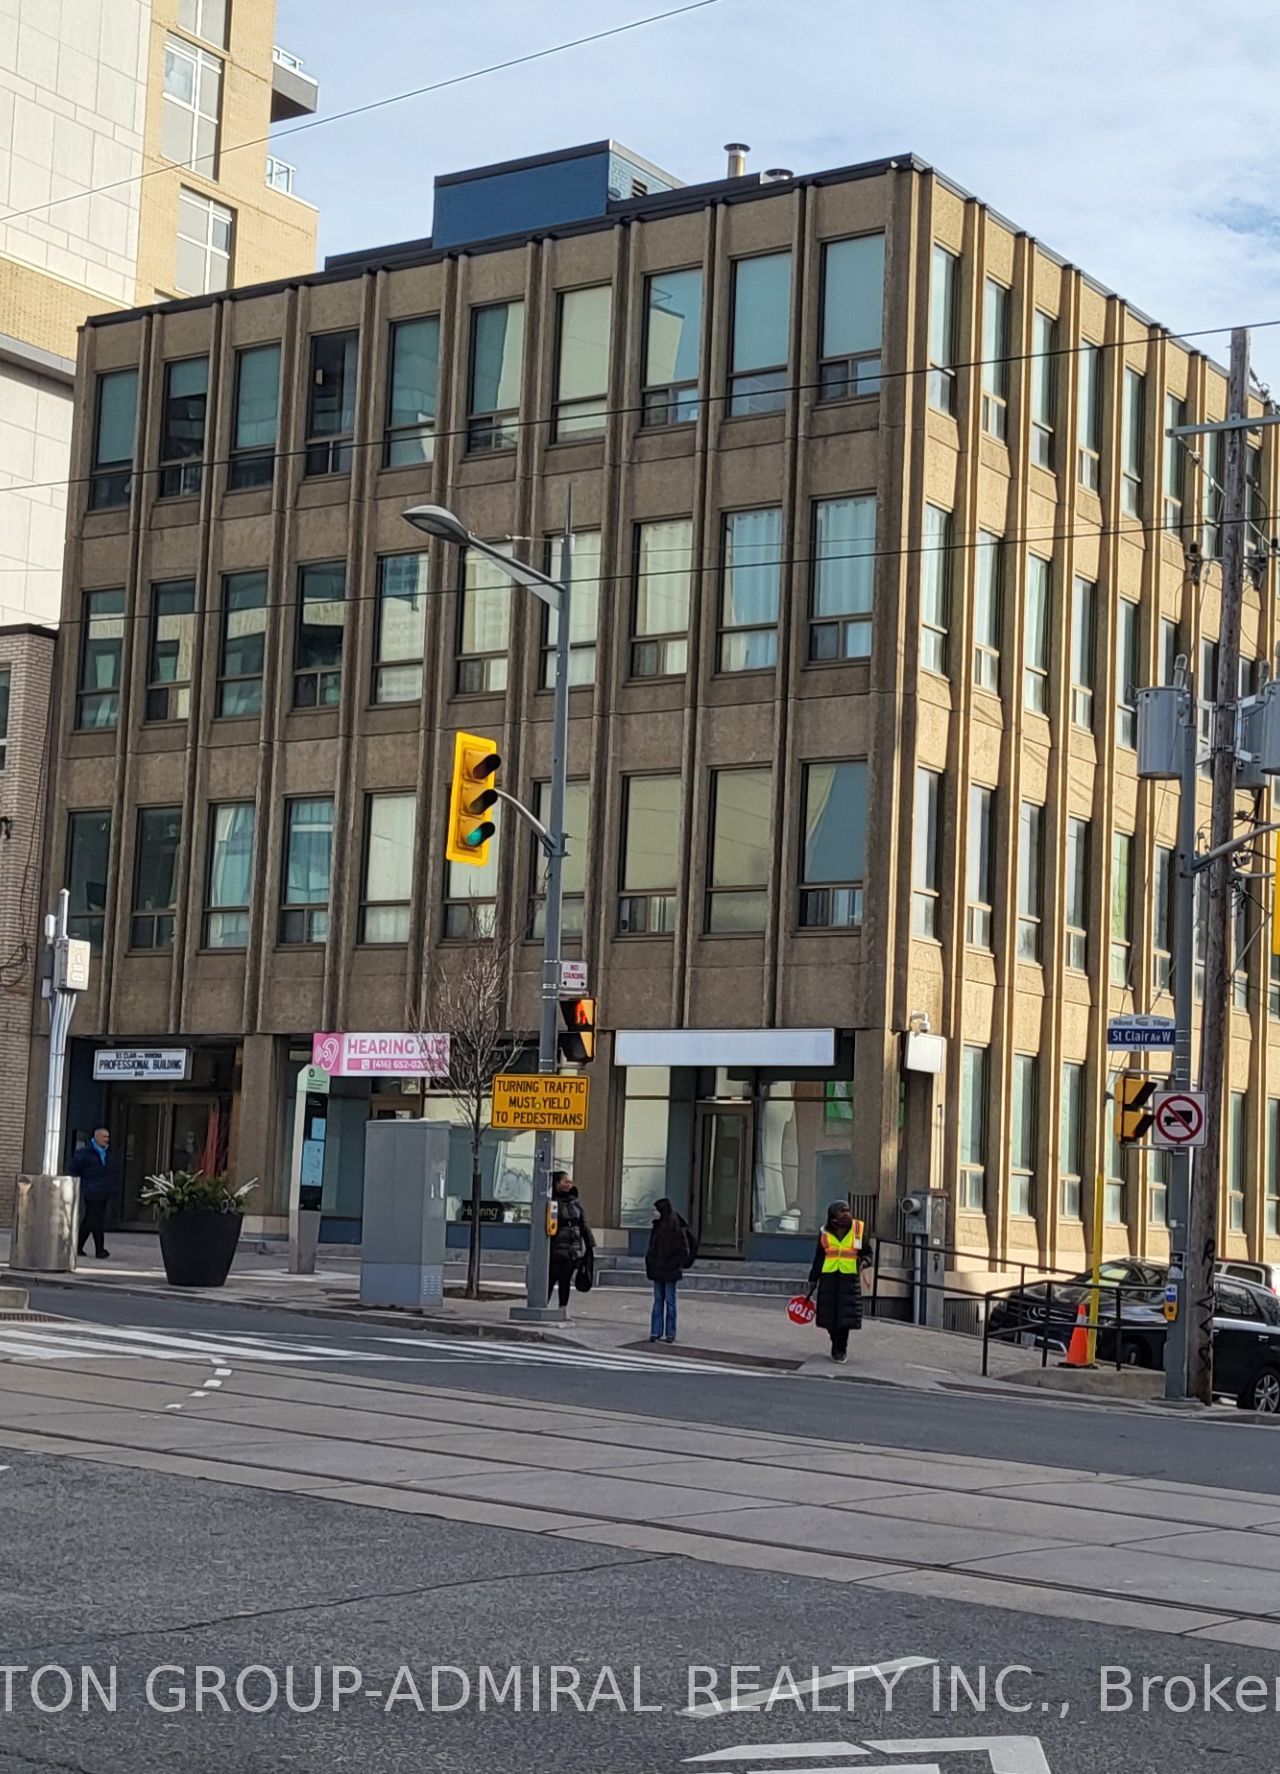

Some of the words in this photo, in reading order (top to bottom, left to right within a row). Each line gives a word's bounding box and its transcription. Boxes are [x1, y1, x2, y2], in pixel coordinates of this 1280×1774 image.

[570, 964, 580, 972] NO
[562, 972, 586, 980] STANDING
[1112, 1030, 1122, 1042] St
[1124, 1030, 1149, 1042] Clair
[1150, 1033, 1160, 1041] Av
[1161, 1031, 1171, 1042] W
[347, 1038, 414, 1055] HEARING
[99, 1059, 150, 1070] PROFESSIONAL
[152, 1059, 183, 1070] BUILDING
[372, 1060, 392, 1070] (416)
[497, 1080, 540, 1094] TURNING
[543, 1081, 585, 1094] TRAFFIC
[508, 1096, 536, 1109] MUST
[541, 1096, 571, 1110] YIELD
[495, 1111, 508, 1124] TO
[512, 1111, 583, 1125] PEDESTRIANS
[788, 1301, 815, 1320] STOP
